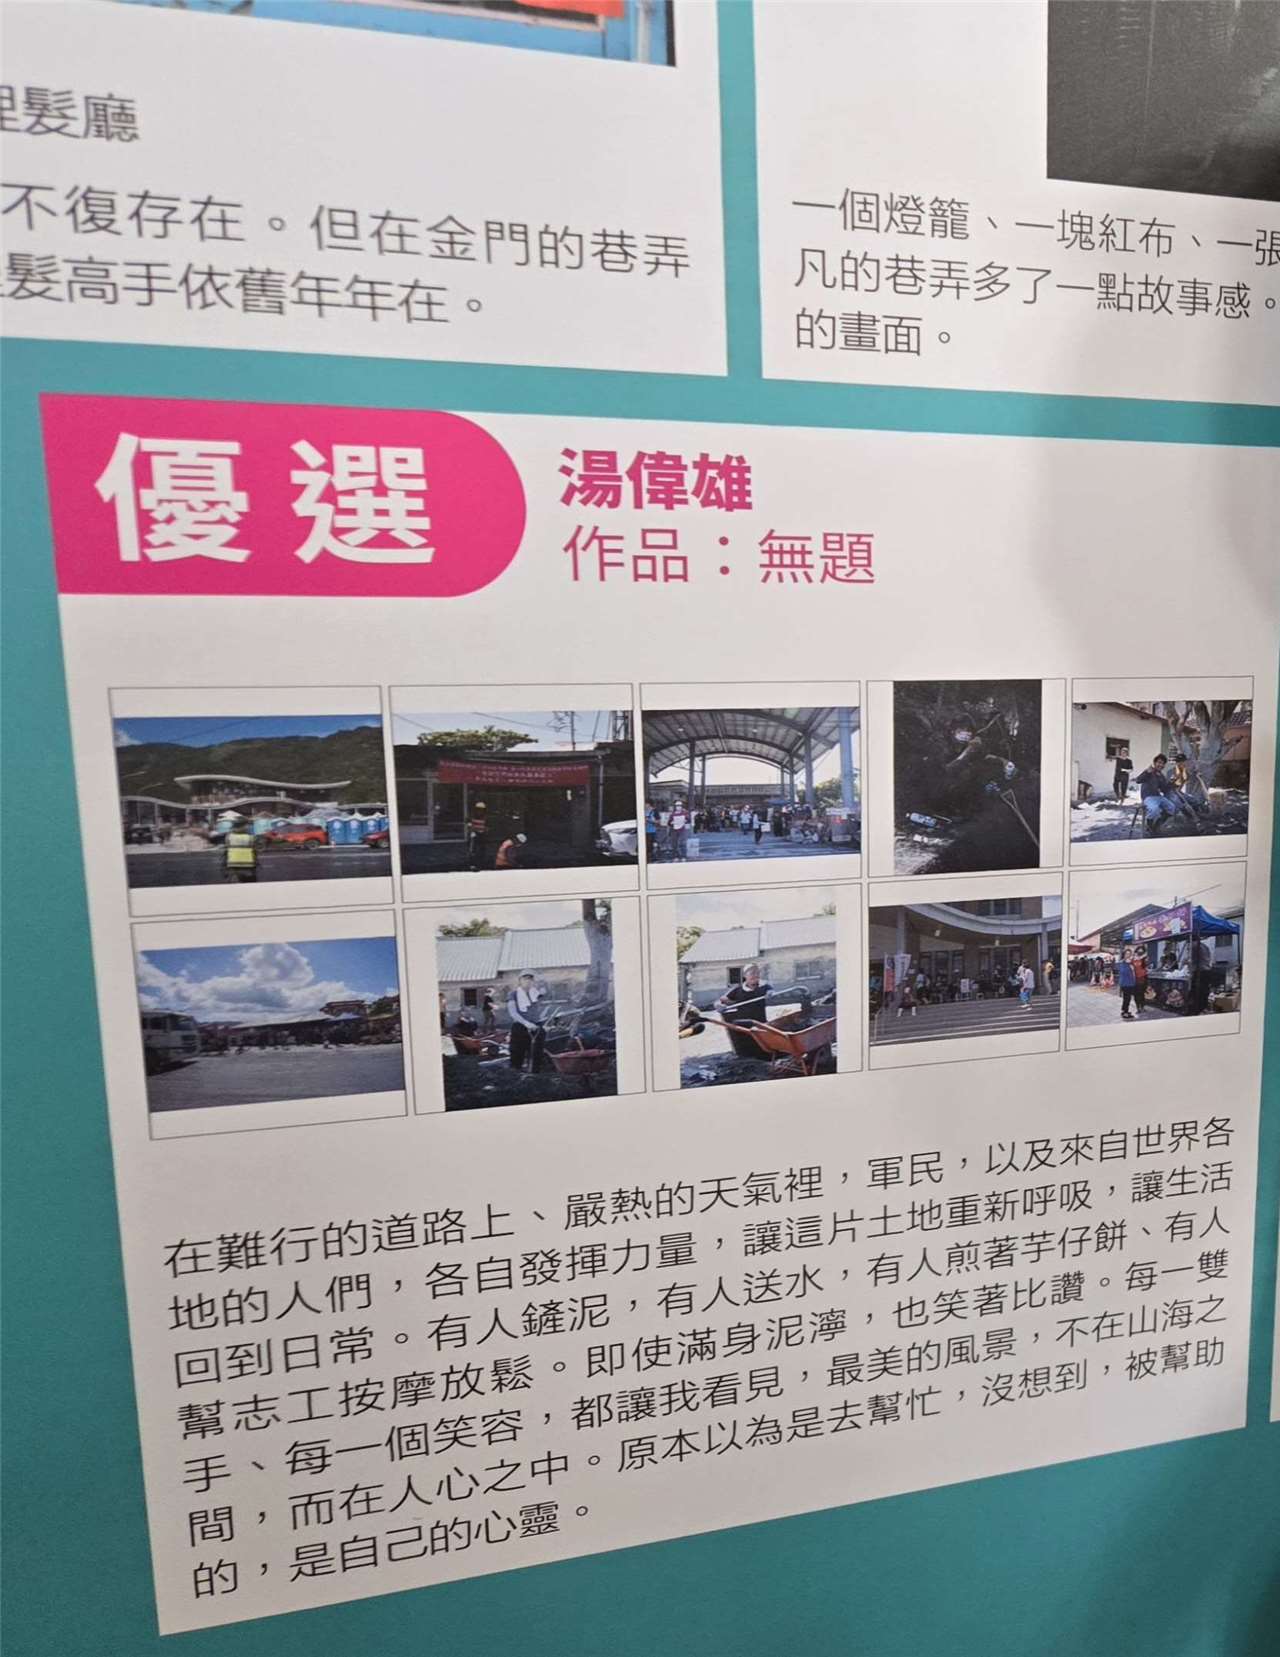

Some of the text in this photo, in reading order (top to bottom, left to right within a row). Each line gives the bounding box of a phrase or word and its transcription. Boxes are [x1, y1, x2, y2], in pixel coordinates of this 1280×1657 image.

[0, 252, 483, 325] 髮高手依舊年年在。
[1, 182, 690, 279] 不復存在。但在金門的巷弄
[796, 307, 951, 356] 的畫面。
[558, 447, 753, 513] 湯偉雄
[562, 525, 876, 585] 作品：無題
[163, 1115, 1236, 1280] 在難行的道路上、嚴熱的天氣裡，軍民，以及來自世界各
[167, 1160, 1234, 1331] 地的人們，各自發揮力量，讓這片土地重新呼吸，讓生活
[173, 1206, 1231, 1389] 回到日常。有人鏟泥，有人送水，有人煎著芋仔餅、有人
[176, 1248, 1229, 1441] 幫志工按摩放鬆。即使滿身泥濘，也笑著比讚。每一雙
[182, 1293, 1228, 1494] 手、每一個笑容，都讓我看見，最美的風景，不在山海之
[187, 1335, 1226, 1548] 間，而在人心之中。原本以為是去幫忙，沒想到，被幫助
[192, 1500, 589, 1600] 的，是自己的心靈。
